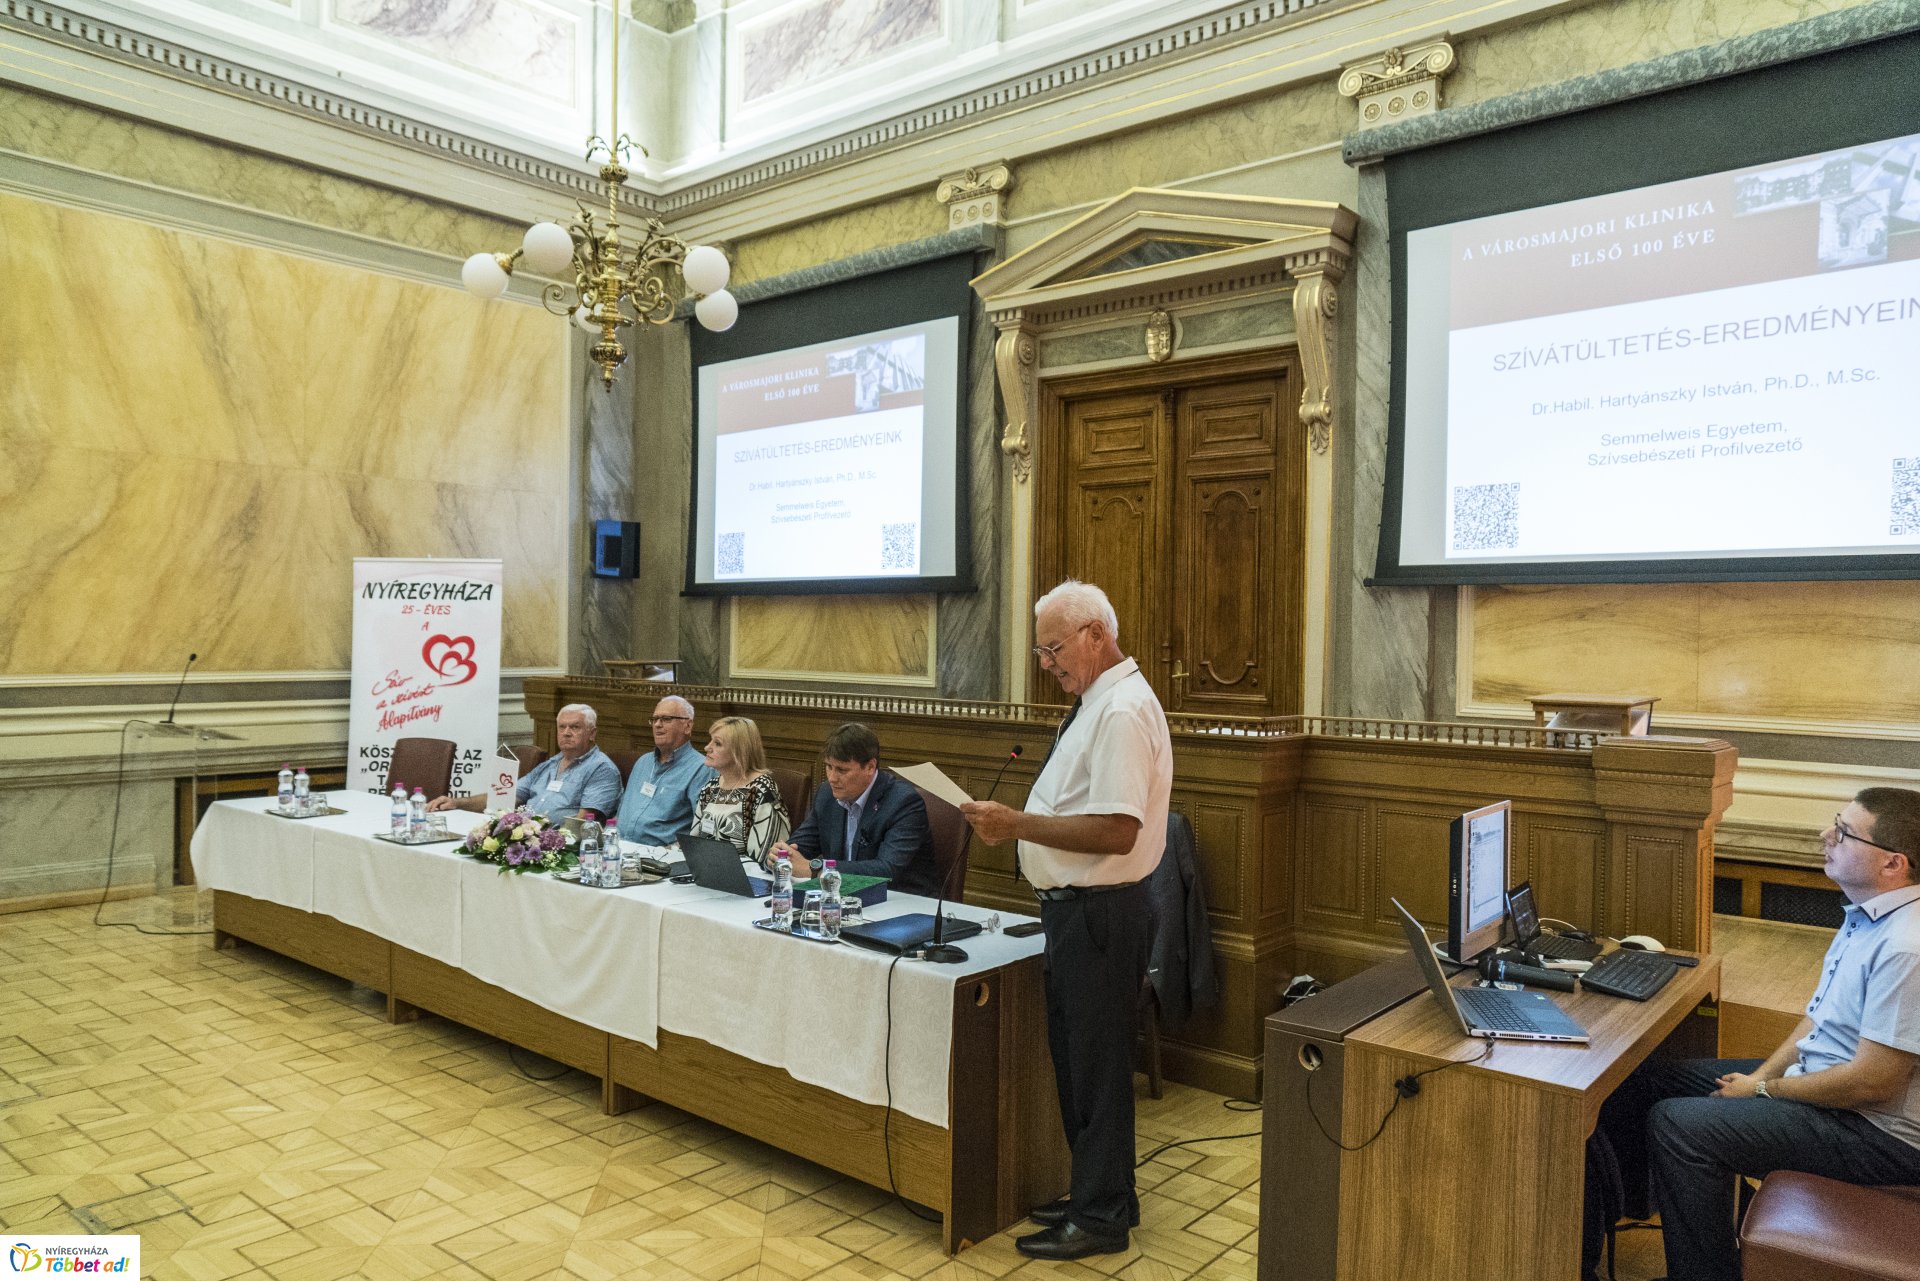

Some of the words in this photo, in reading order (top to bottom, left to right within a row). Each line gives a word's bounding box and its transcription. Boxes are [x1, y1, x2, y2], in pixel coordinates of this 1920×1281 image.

[1463, 248, 1473, 261] A
[1481, 220, 1616, 257] VÁROSMAJORI
[1625, 200, 1715, 230] KLINIKA
[1571, 244, 1622, 267] ELSŐ
[1632, 239, 1663, 257] 100
[1673, 228, 1715, 249] ÉVE
[1492, 297, 1920, 372] SZÍVÁTÜLTETÉS-EREDMÉNYEIN
[721, 385, 728, 393] A
[730, 373, 782, 391] VÁROSMAJORI
[785, 367, 820, 381] KLINIKA
[788, 388, 800, 397] 100
[803, 383, 820, 395] ÉVE
[1532, 397, 1594, 416] Dr.Habil.
[1599, 387, 1697, 409] Hartyánszky
[1703, 380, 1757, 399] István,
[1764, 374, 1820, 391] Ph.D.,
[1826, 366, 1881, 386] M.Sc.
[1601, 426, 1701, 447] Semmelweis
[1707, 419, 1788, 441] Egyetem,
[1587, 445, 1696, 467] Szívsebészeti
[1701, 437, 1803, 459] Profilvezető
[362, 580, 494, 601] NYÍREGYHÁZA
[401, 604, 415, 615] 25
[424, 604, 452, 616] ÉVES
[421, 621, 430, 631] A
[463, 749, 482, 761] AZ
